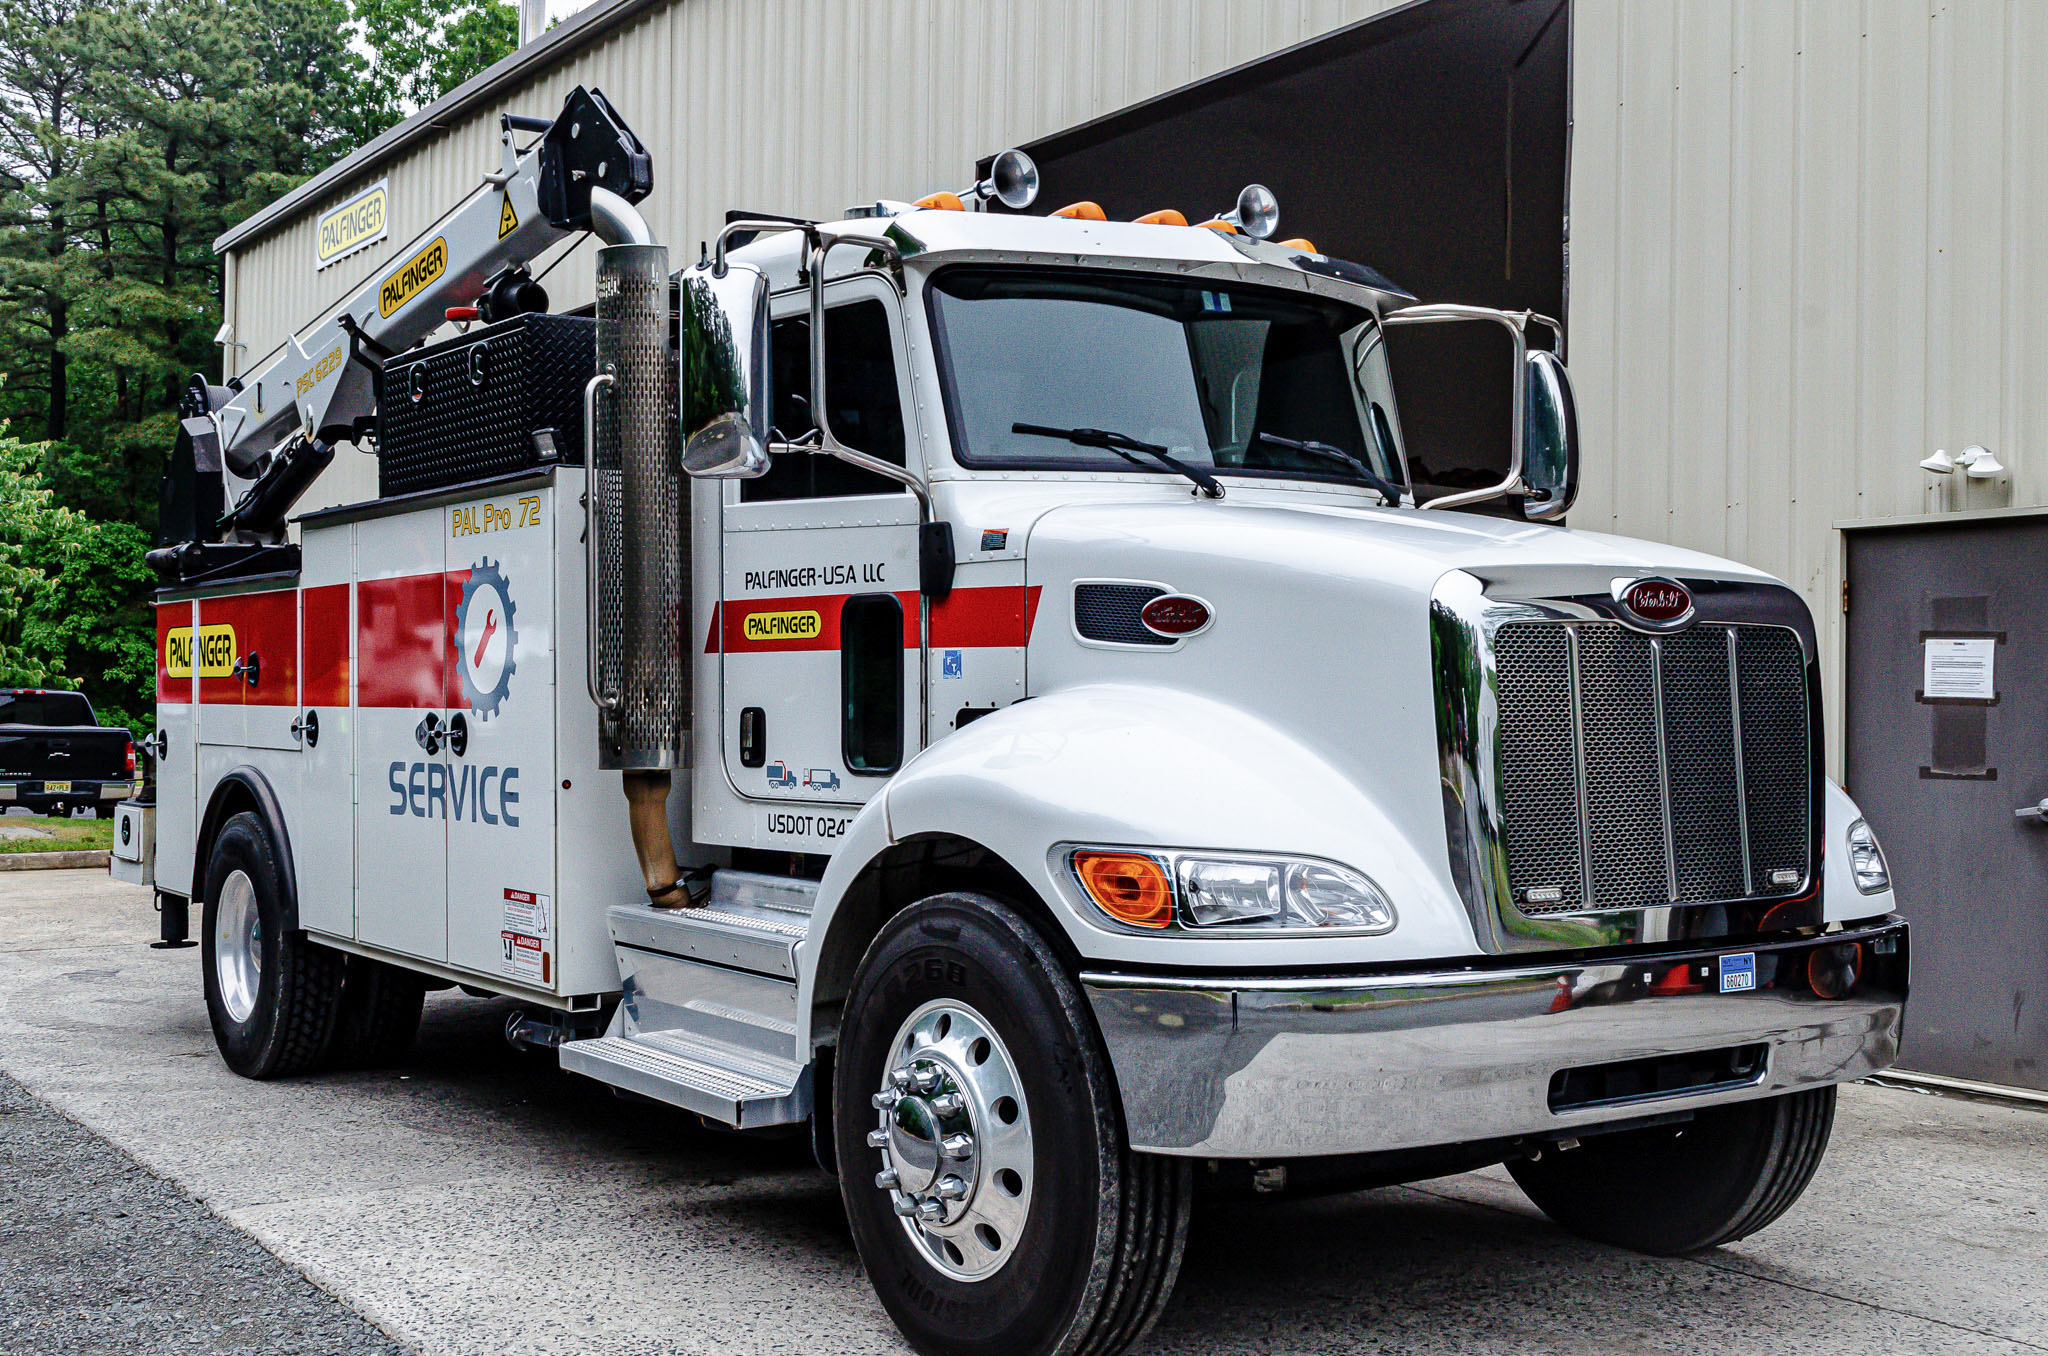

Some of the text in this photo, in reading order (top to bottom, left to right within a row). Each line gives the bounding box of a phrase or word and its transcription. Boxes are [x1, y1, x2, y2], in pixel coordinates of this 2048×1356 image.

[321, 196, 382, 254] PALFINGER
[382, 245, 444, 312] PALFINGER
[296, 346, 342, 399] PSC 6229
[452, 495, 540, 537] PAL Pro 72
[745, 562, 886, 590] PALFINGER-USA LLC
[1633, 588, 1684, 610] Peterbilt
[748, 615, 816, 636] PALFINGER
[169, 634, 232, 668] PALFNGER
[388, 761, 520, 828] SERVICE
[767, 813, 854, 838] USDOT 024
[520, 936, 540, 948] DANGER
